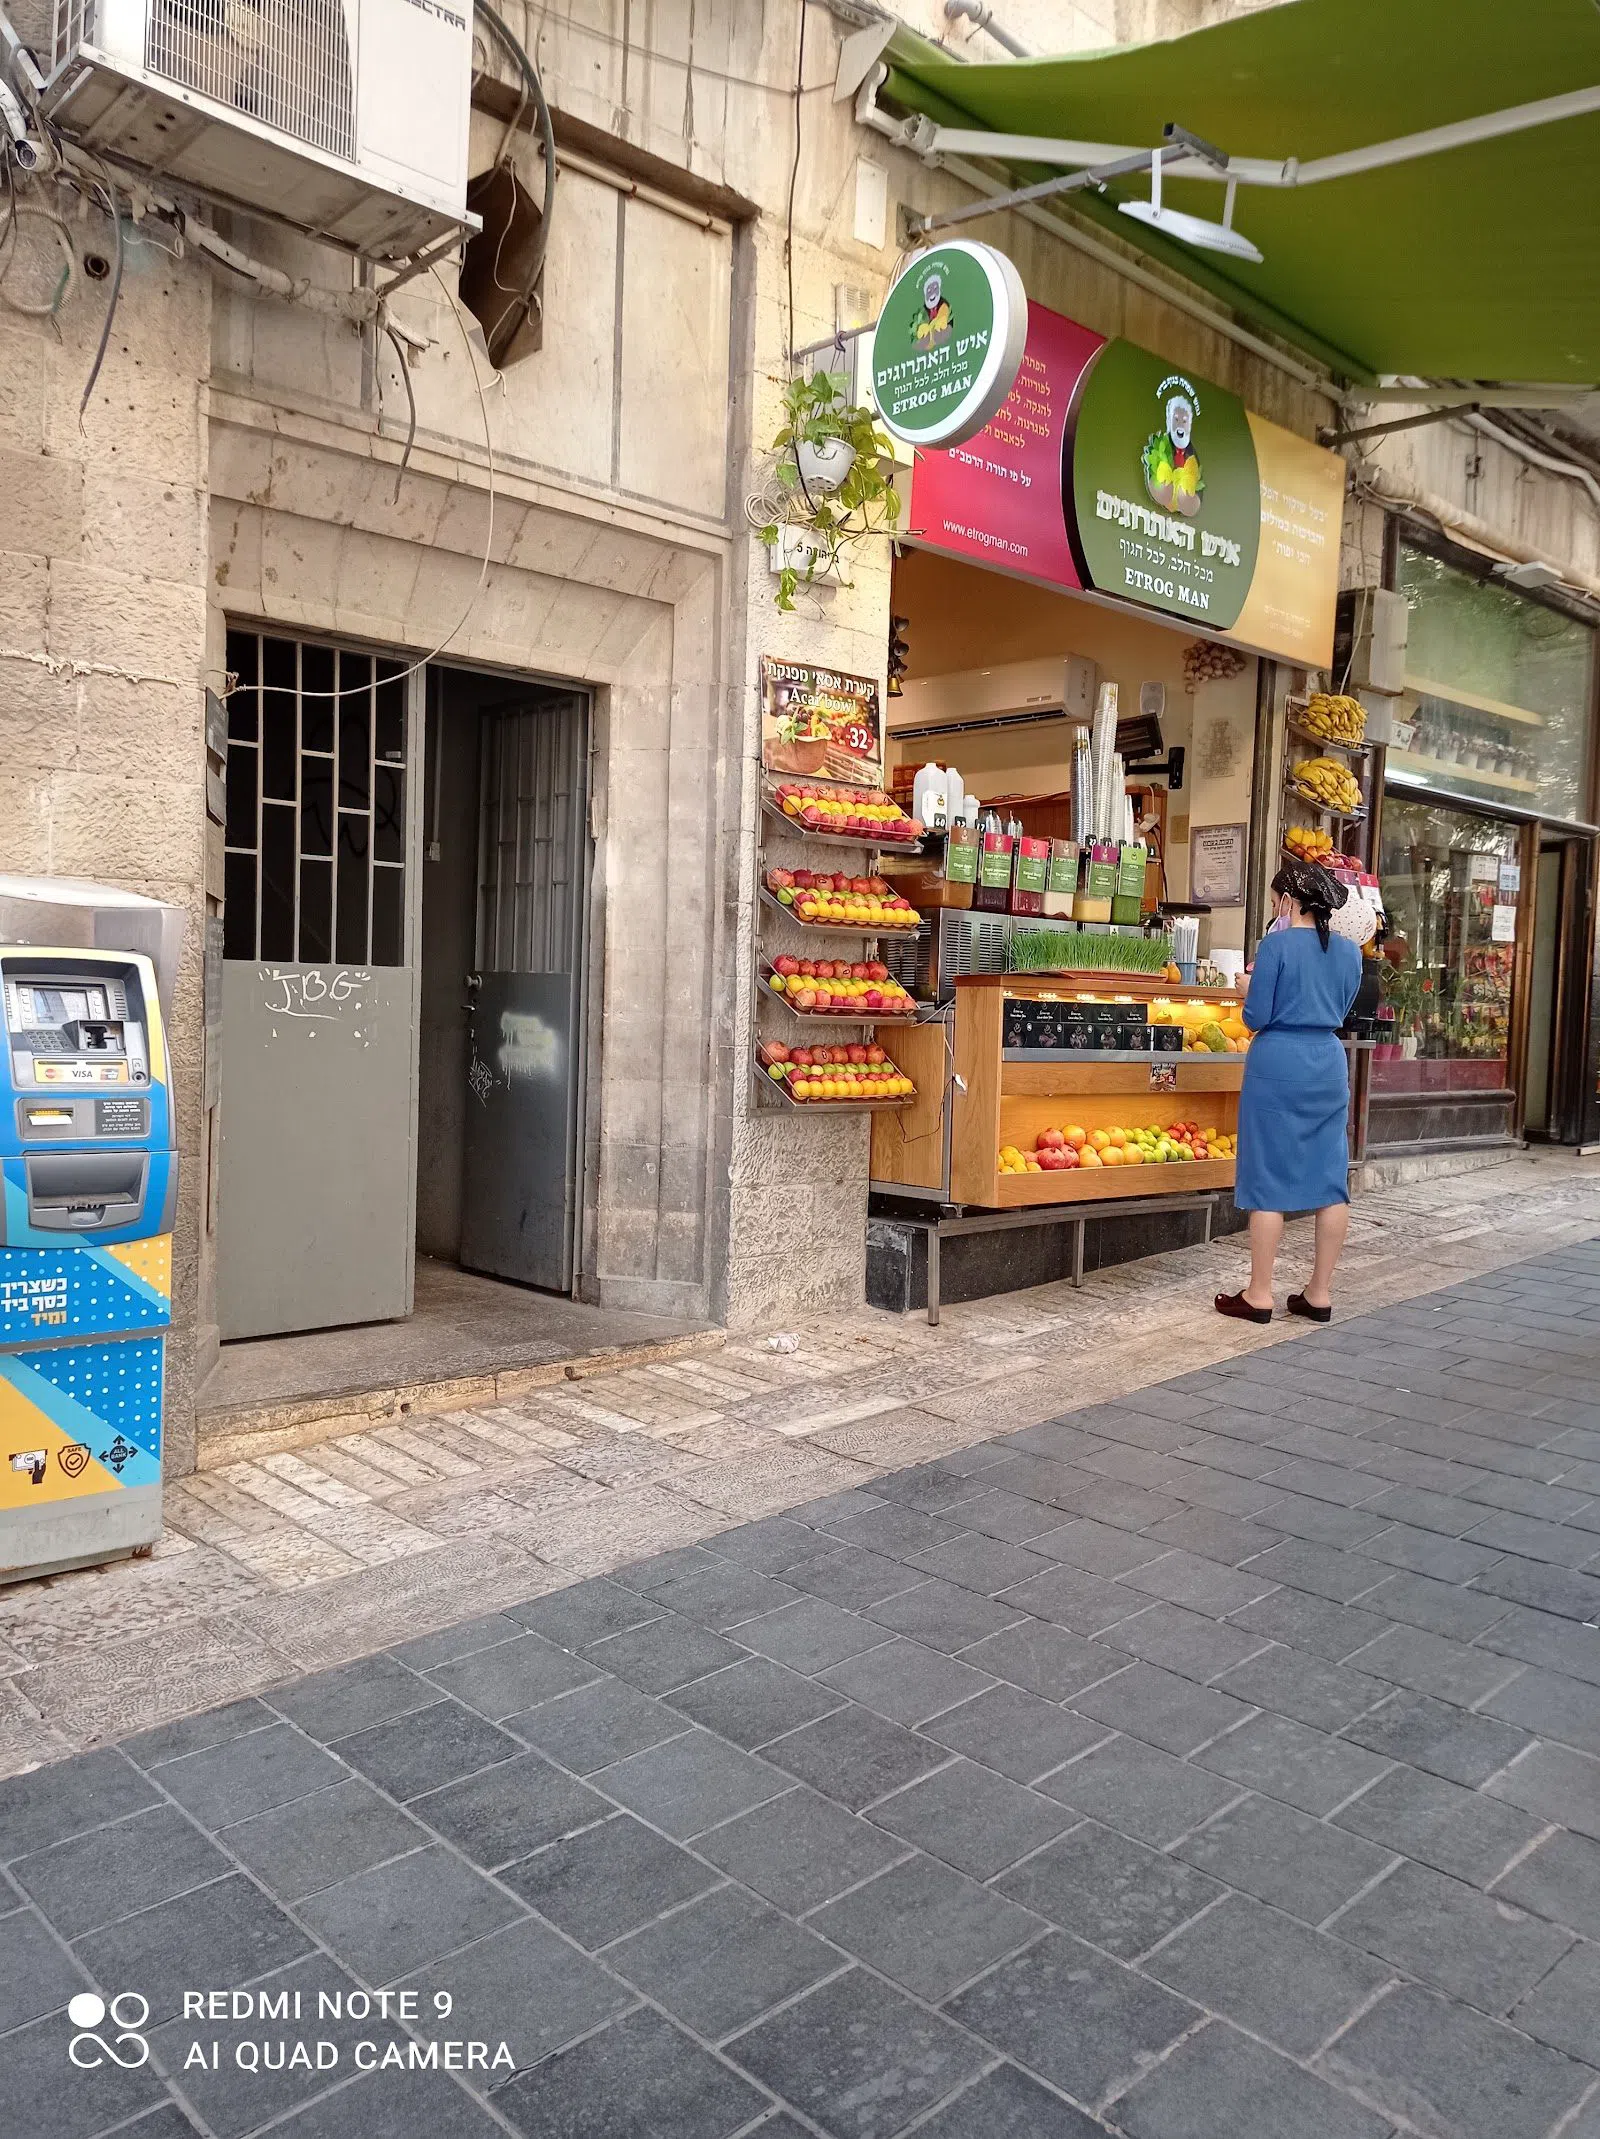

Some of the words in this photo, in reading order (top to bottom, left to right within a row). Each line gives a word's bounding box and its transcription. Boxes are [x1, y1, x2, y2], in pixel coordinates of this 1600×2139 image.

[956, 330, 988, 356] איש
[877, 346, 950, 387] האתרוגים
[931, 367, 950, 382] הלב,
[951, 361, 968, 374] מכל
[894, 382, 913, 398] הגוף
[914, 373, 930, 389] לכל
[892, 388, 937, 416] ETROG
[940, 374, 972, 398] MAN
[994, 427, 1026, 449] לכאבים
[985, 461, 1007, 479] תורת
[1010, 470, 1018, 483] פי
[1021, 470, 1032, 487] על
[1096, 489, 1196, 551] האתרוגים
[797, 541, 803, 553] 5
[943, 520, 1028, 556] www.etrogman.com
[1119, 538, 1143, 559] הגוף
[1201, 530, 1241, 567] איש
[806, 546, 830, 560] יהוה
[1146, 541, 1166, 566] לכל
[1167, 552, 1191, 576] הלב,
[1194, 559, 1214, 583] מכל
[1124, 567, 1174, 598] ETROG
[1178, 585, 1210, 610] MAN
[767, 662, 809, 683] מפנקת
[790, 687, 821, 707] Acai
[825, 694, 856, 714] bowl
[845, 679, 875, 702] קערת
[0, 1278, 67, 1298] כשצריך
[1, 1298, 29, 1312] ביד
[32, 1294, 67, 1312] כסף
[31, 1311, 67, 1326] ומיד
